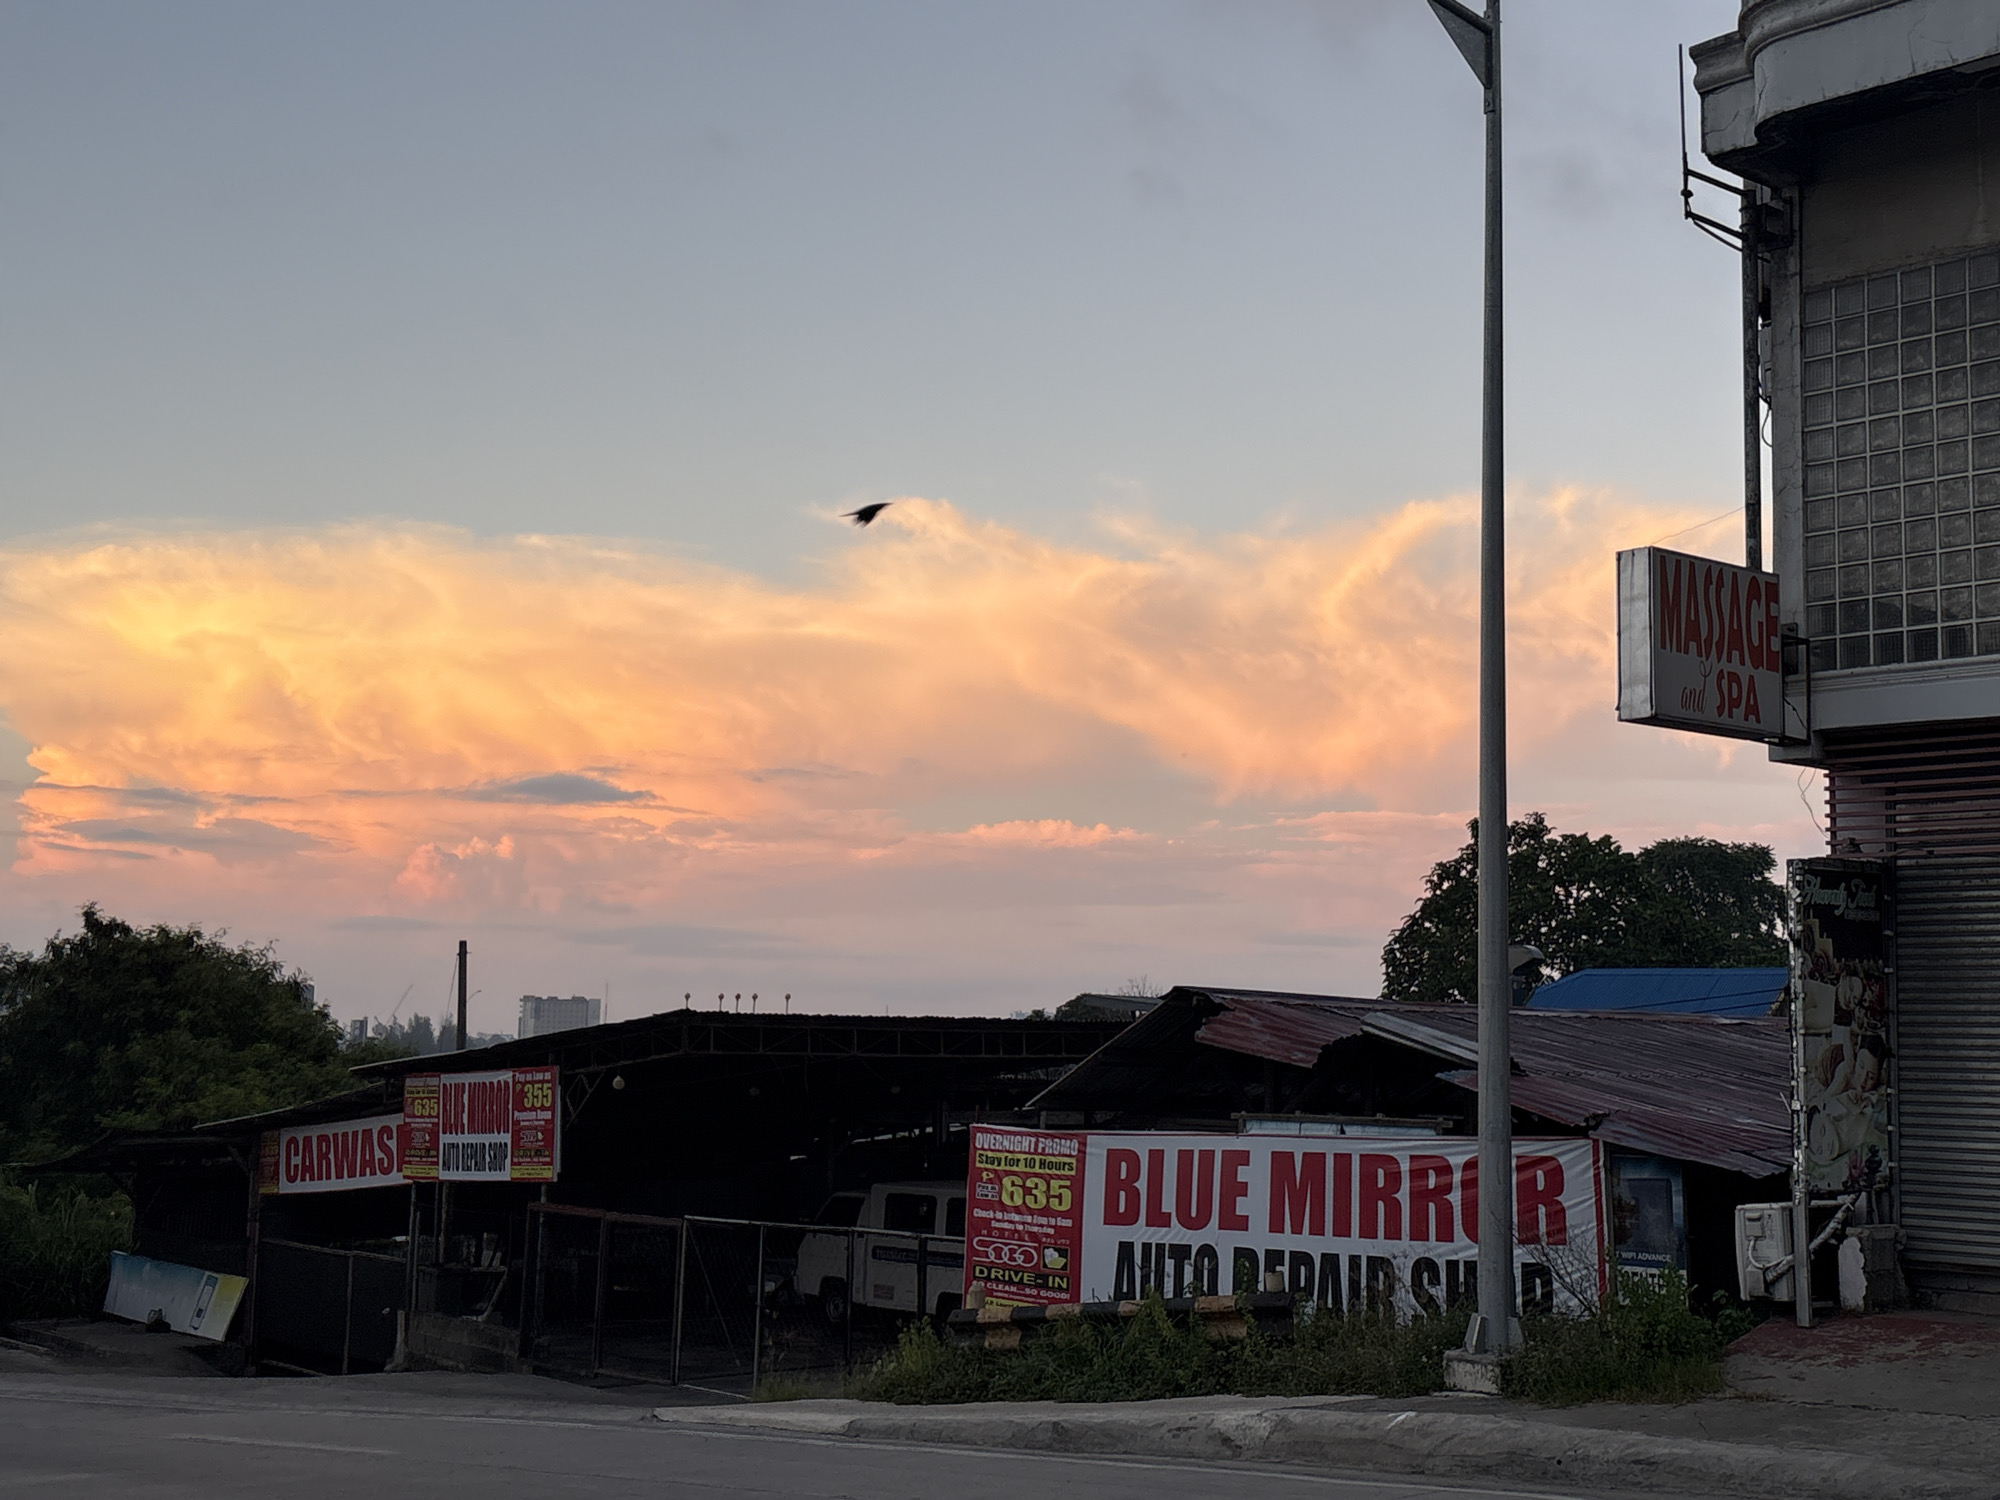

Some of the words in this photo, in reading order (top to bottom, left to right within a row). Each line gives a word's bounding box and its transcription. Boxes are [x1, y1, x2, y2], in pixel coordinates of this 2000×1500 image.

[1660, 555, 1779, 673] MASSAGE
[1681, 661, 1713, 714] and
[1716, 668, 1761, 724] SPA
[414, 1099, 438, 1117] 635
[442, 1082, 466, 1135] BLUE
[467, 1079, 510, 1135] MIRROR
[523, 1083, 552, 1108] 355
[442, 1142, 460, 1172] AUTO
[461, 1142, 486, 1172] REPAIR
[487, 1141, 508, 1173] SHOP
[975, 1132, 1037, 1152] OVERNIGHT
[1038, 1137, 1079, 1156] PROMO
[978, 1153, 1002, 1167] Stay
[1004, 1155, 1021, 1167] for
[1023, 1157, 1036, 1169] 10
[1038, 1158, 1074, 1172] Hours
[1001, 1175, 1072, 1212] 635
[1103, 1148, 1250, 1231] BLUE
[981, 1229, 1031, 1241] HOTEL
[972, 1236, 1039, 1267] SOGO
[1637, 1252, 1672, 1262] ADVANCE
[1114, 1241, 1218, 1300] AUTO
[1411, 1257, 1553, 1316] SHP
[1040, 1289, 1070, 1300] GOOD!
